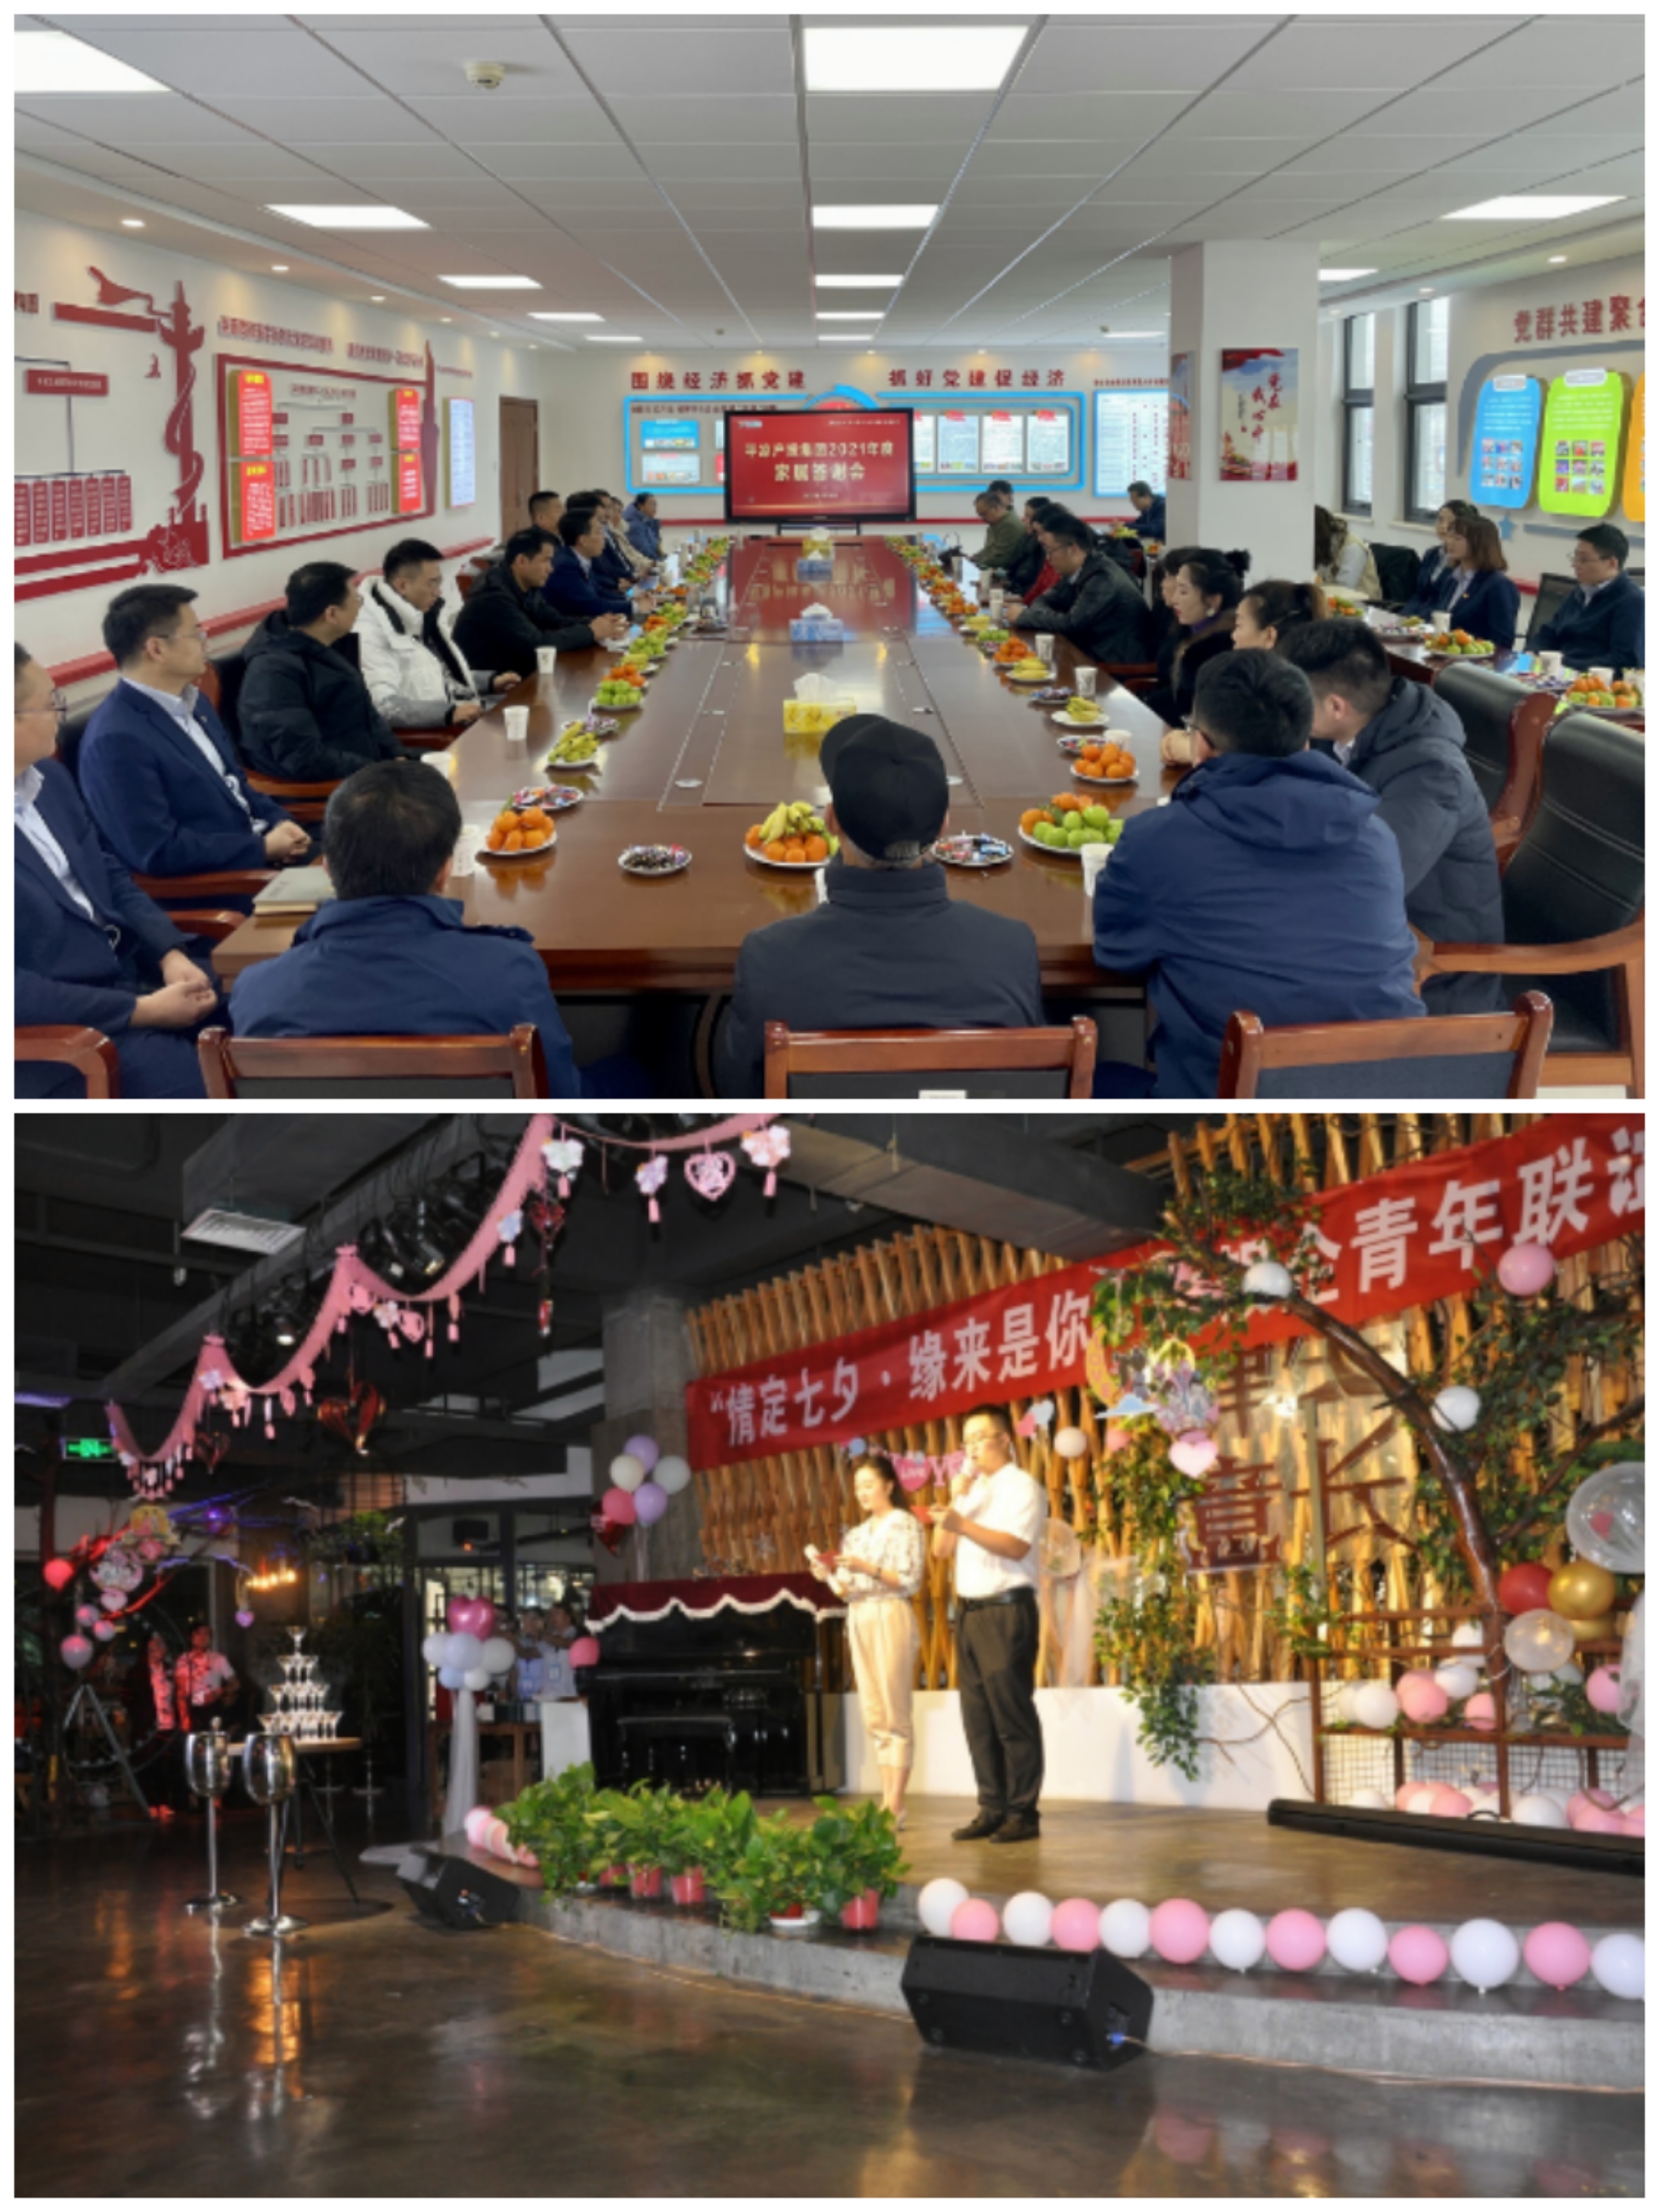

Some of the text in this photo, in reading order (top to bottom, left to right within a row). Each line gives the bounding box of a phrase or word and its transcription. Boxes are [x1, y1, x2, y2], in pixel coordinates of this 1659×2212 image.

[889, 369, 1065, 387] 抓好党建促经济
